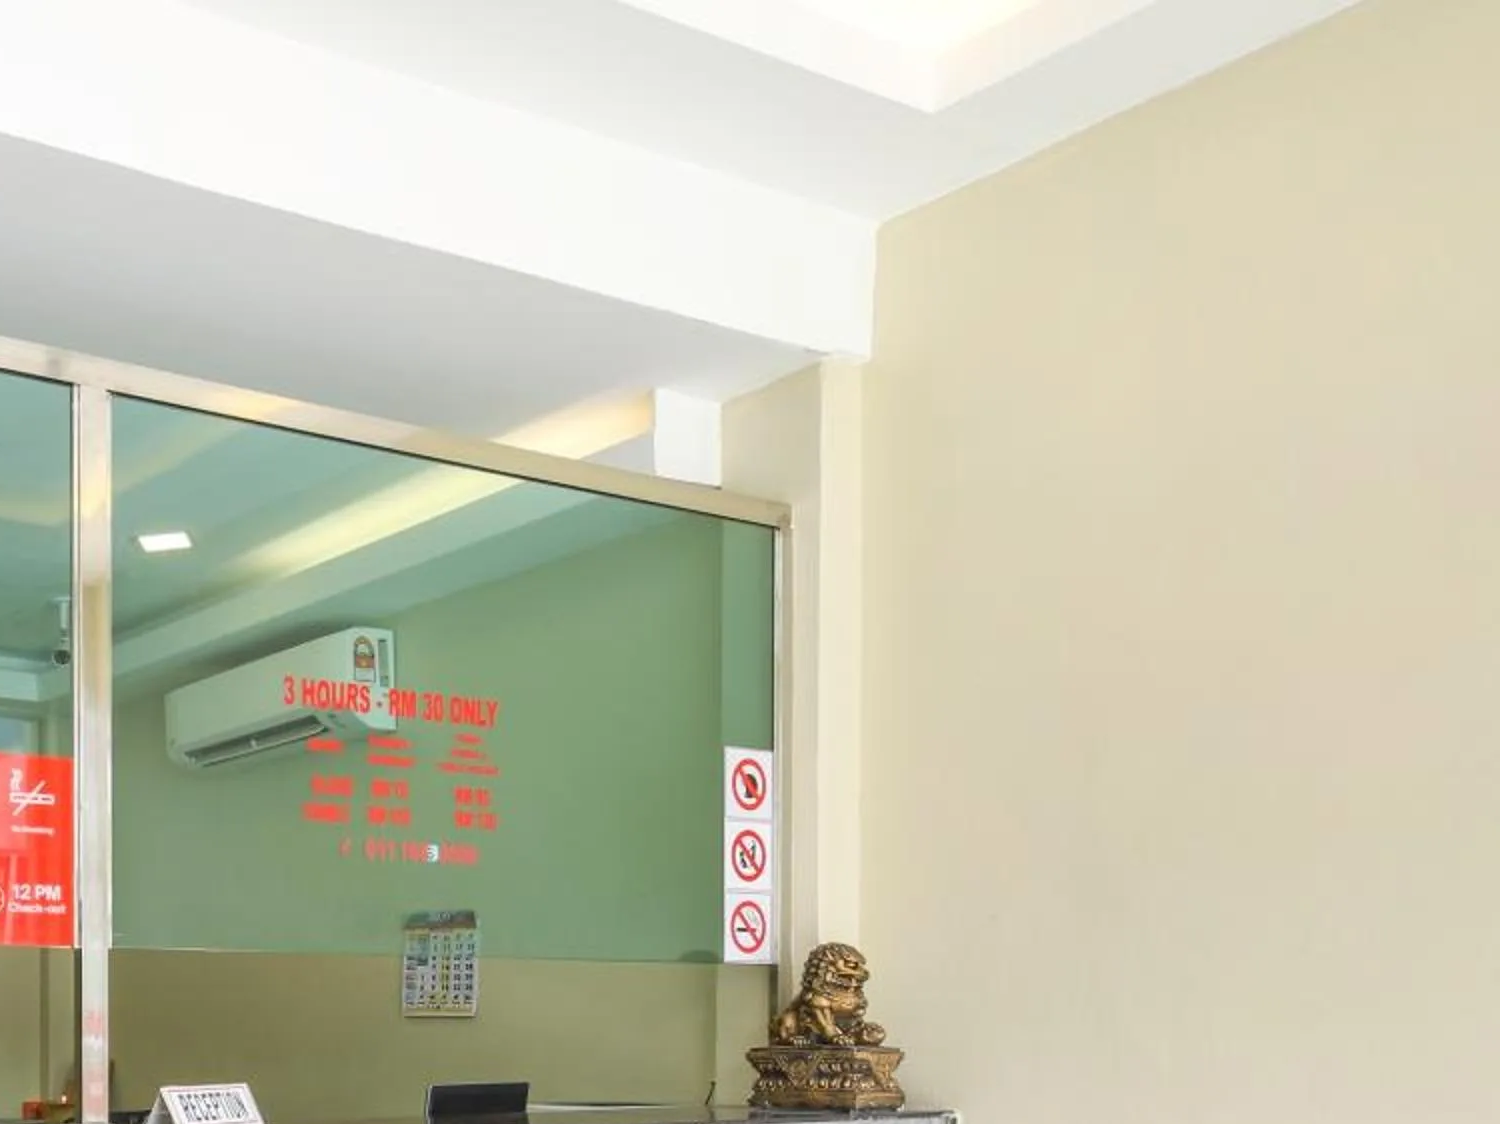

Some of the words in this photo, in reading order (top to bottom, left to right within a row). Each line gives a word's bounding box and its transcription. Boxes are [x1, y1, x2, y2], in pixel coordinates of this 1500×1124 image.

[284, 675, 295, 705] 3
[302, 678, 371, 714] HOURS
[388, 688, 417, 719] RM
[423, 694, 444, 723] 30
[450, 697, 499, 728] ONLY
[12, 883, 32, 900] 12
[35, 884, 61, 901] PM
